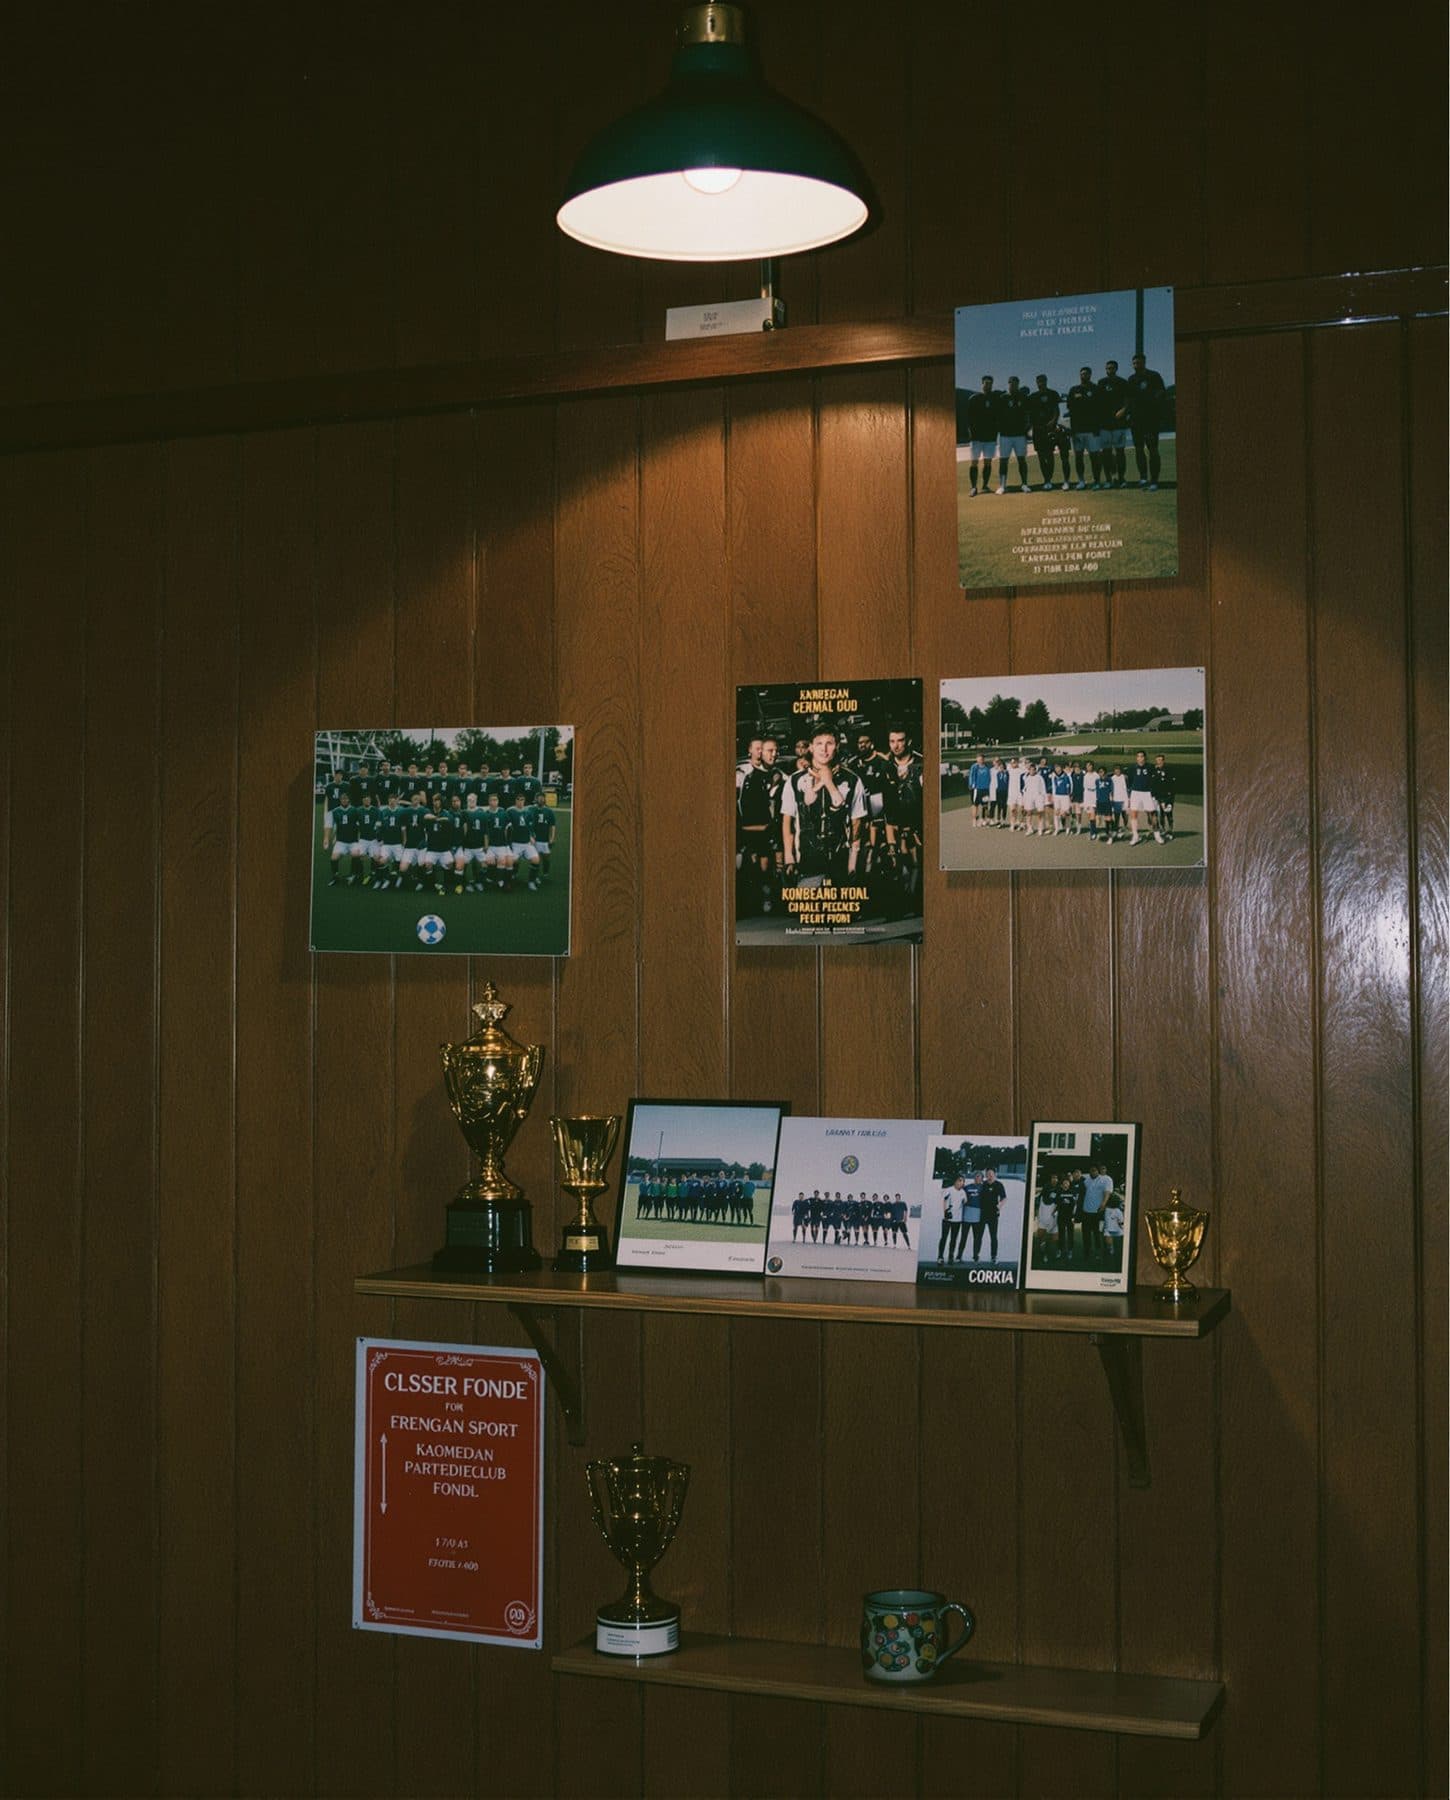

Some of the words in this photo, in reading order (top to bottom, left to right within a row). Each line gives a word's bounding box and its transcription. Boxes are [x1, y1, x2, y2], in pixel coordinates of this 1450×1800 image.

[968, 1269, 1014, 1284] CORKIA
[384, 1372, 458, 1395] CLSSER
[463, 1378, 529, 1400] FONDE
[445, 1402, 464, 1412] FOR
[390, 1415, 464, 1434] FRENGAN
[468, 1421, 519, 1438] SPORT
[416, 1443, 494, 1461] KAOMEDAN
